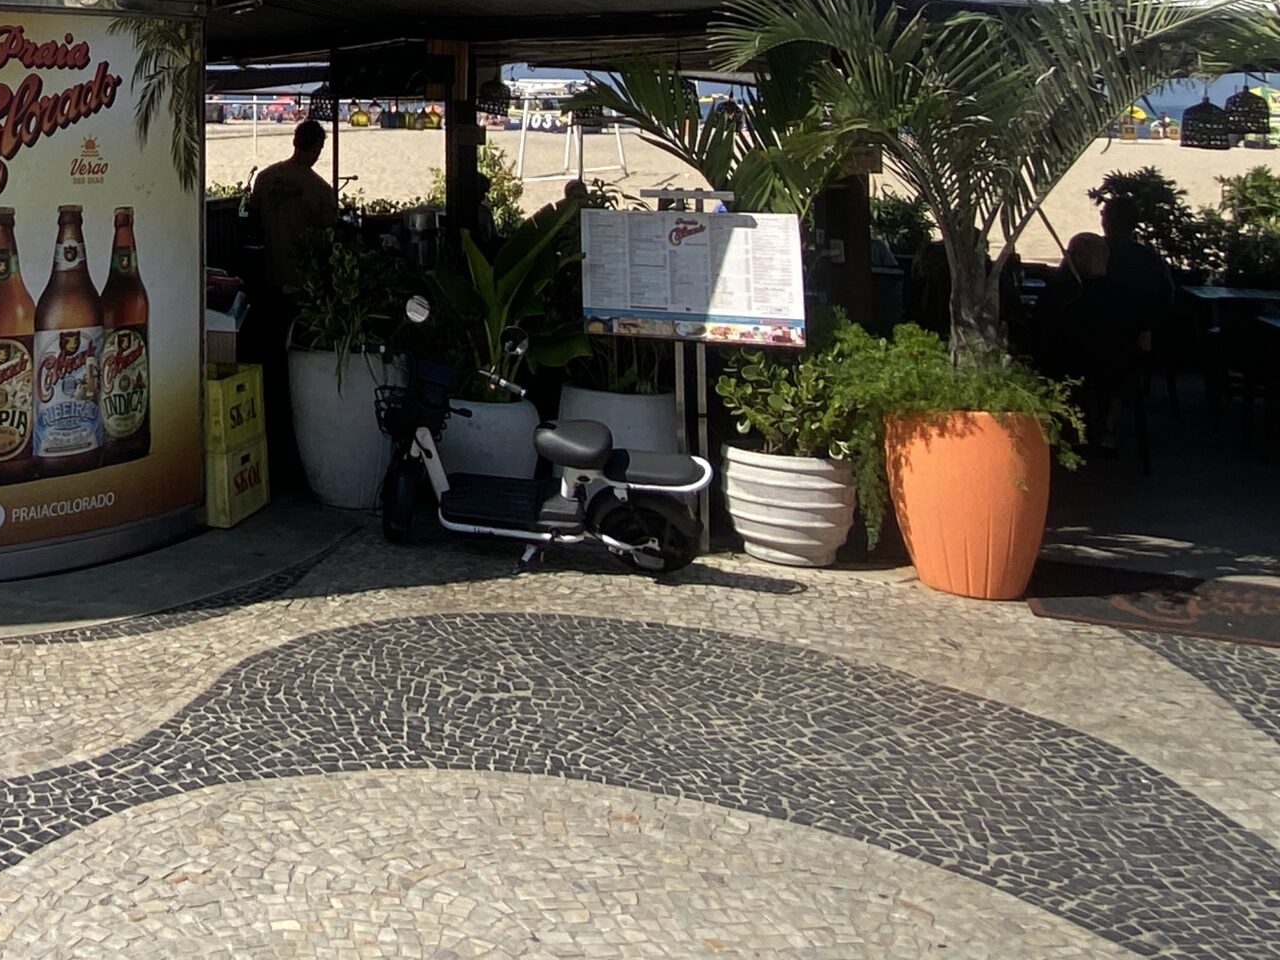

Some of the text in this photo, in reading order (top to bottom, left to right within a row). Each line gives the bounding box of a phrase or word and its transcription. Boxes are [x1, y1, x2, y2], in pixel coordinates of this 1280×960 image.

[70, 157, 109, 176] Verão
[103, 391, 144, 418] INDICA
[11, 492, 115, 523] PRAIACOLORADO
